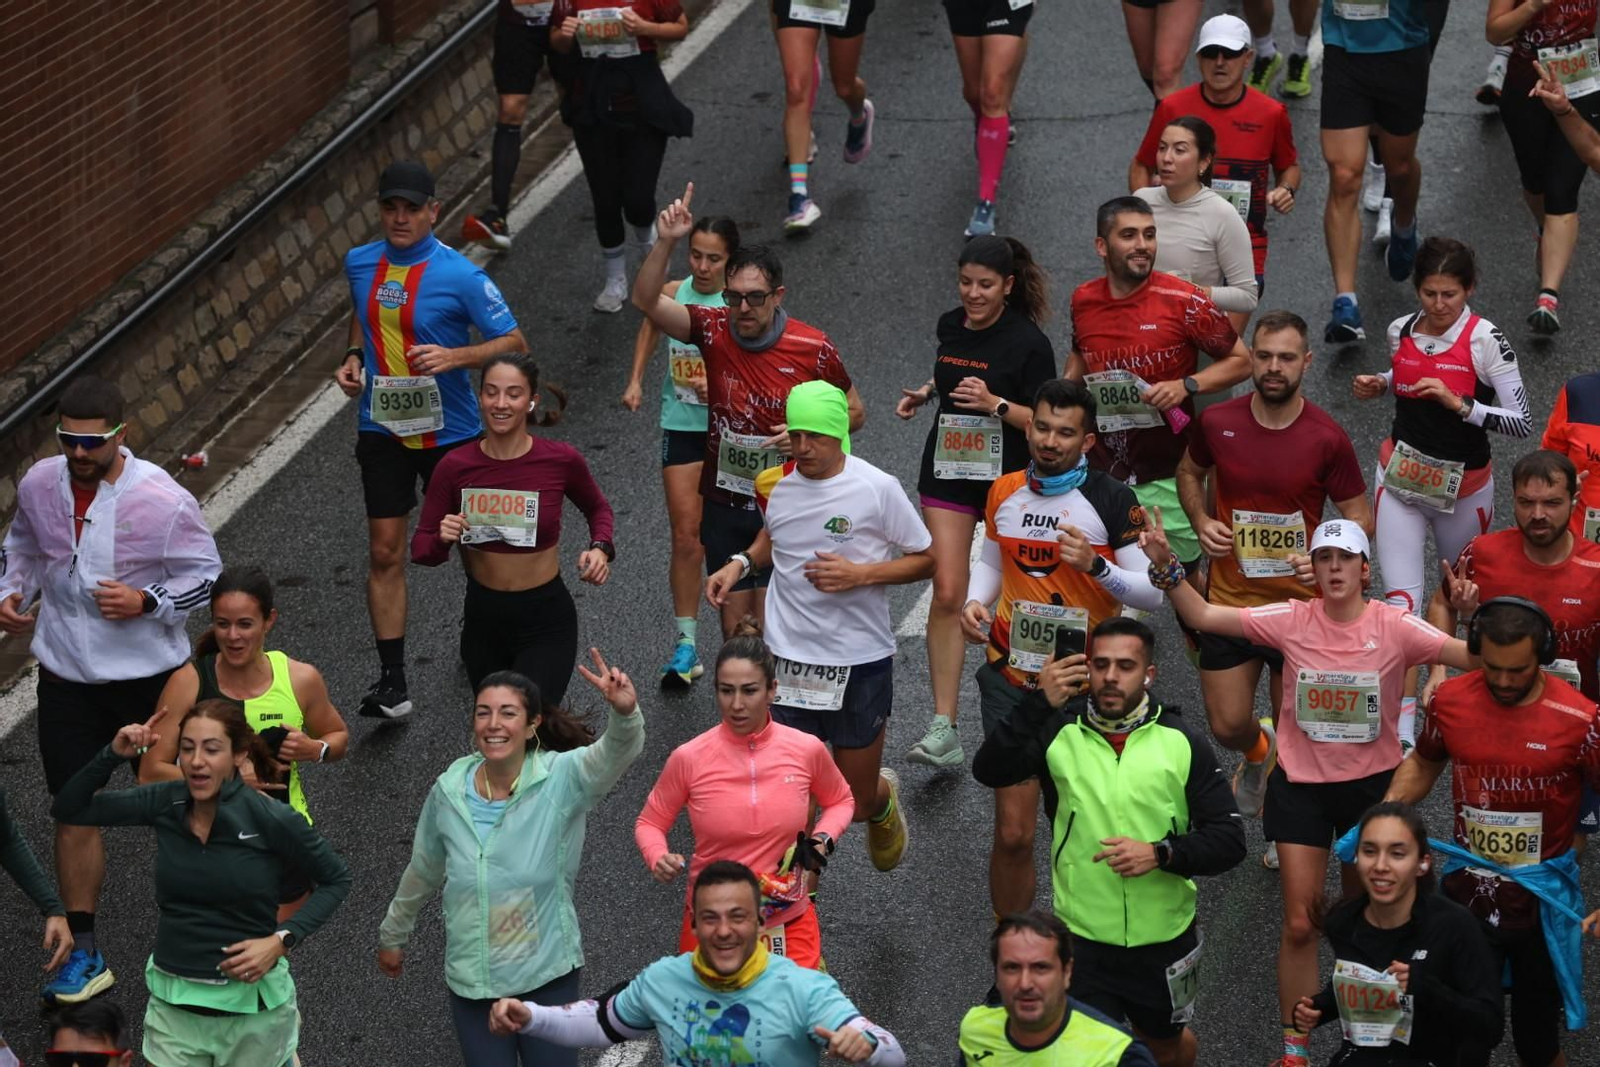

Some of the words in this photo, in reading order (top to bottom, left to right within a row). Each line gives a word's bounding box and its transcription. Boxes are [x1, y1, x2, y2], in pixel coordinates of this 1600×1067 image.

[969, 360, 989, 371] RUN
[380, 391, 424, 411] 9330
[1100, 386, 1140, 406] 8848
[944, 431, 985, 451] 8846
[728, 447, 770, 471] 8851
[1396, 458, 1445, 488] 9926
[468, 494, 526, 516] 10208
[1021, 513, 1059, 531] RUN
[1026, 529, 1048, 538] FOR
[1238, 528, 1296, 549] 11826
[1018, 543, 1053, 562] FUN
[1308, 688, 1360, 712] 9057
[1526, 742, 1547, 751] HOKA
[1469, 827, 1527, 854] 12636
[1338, 983, 1400, 1012] 10124
